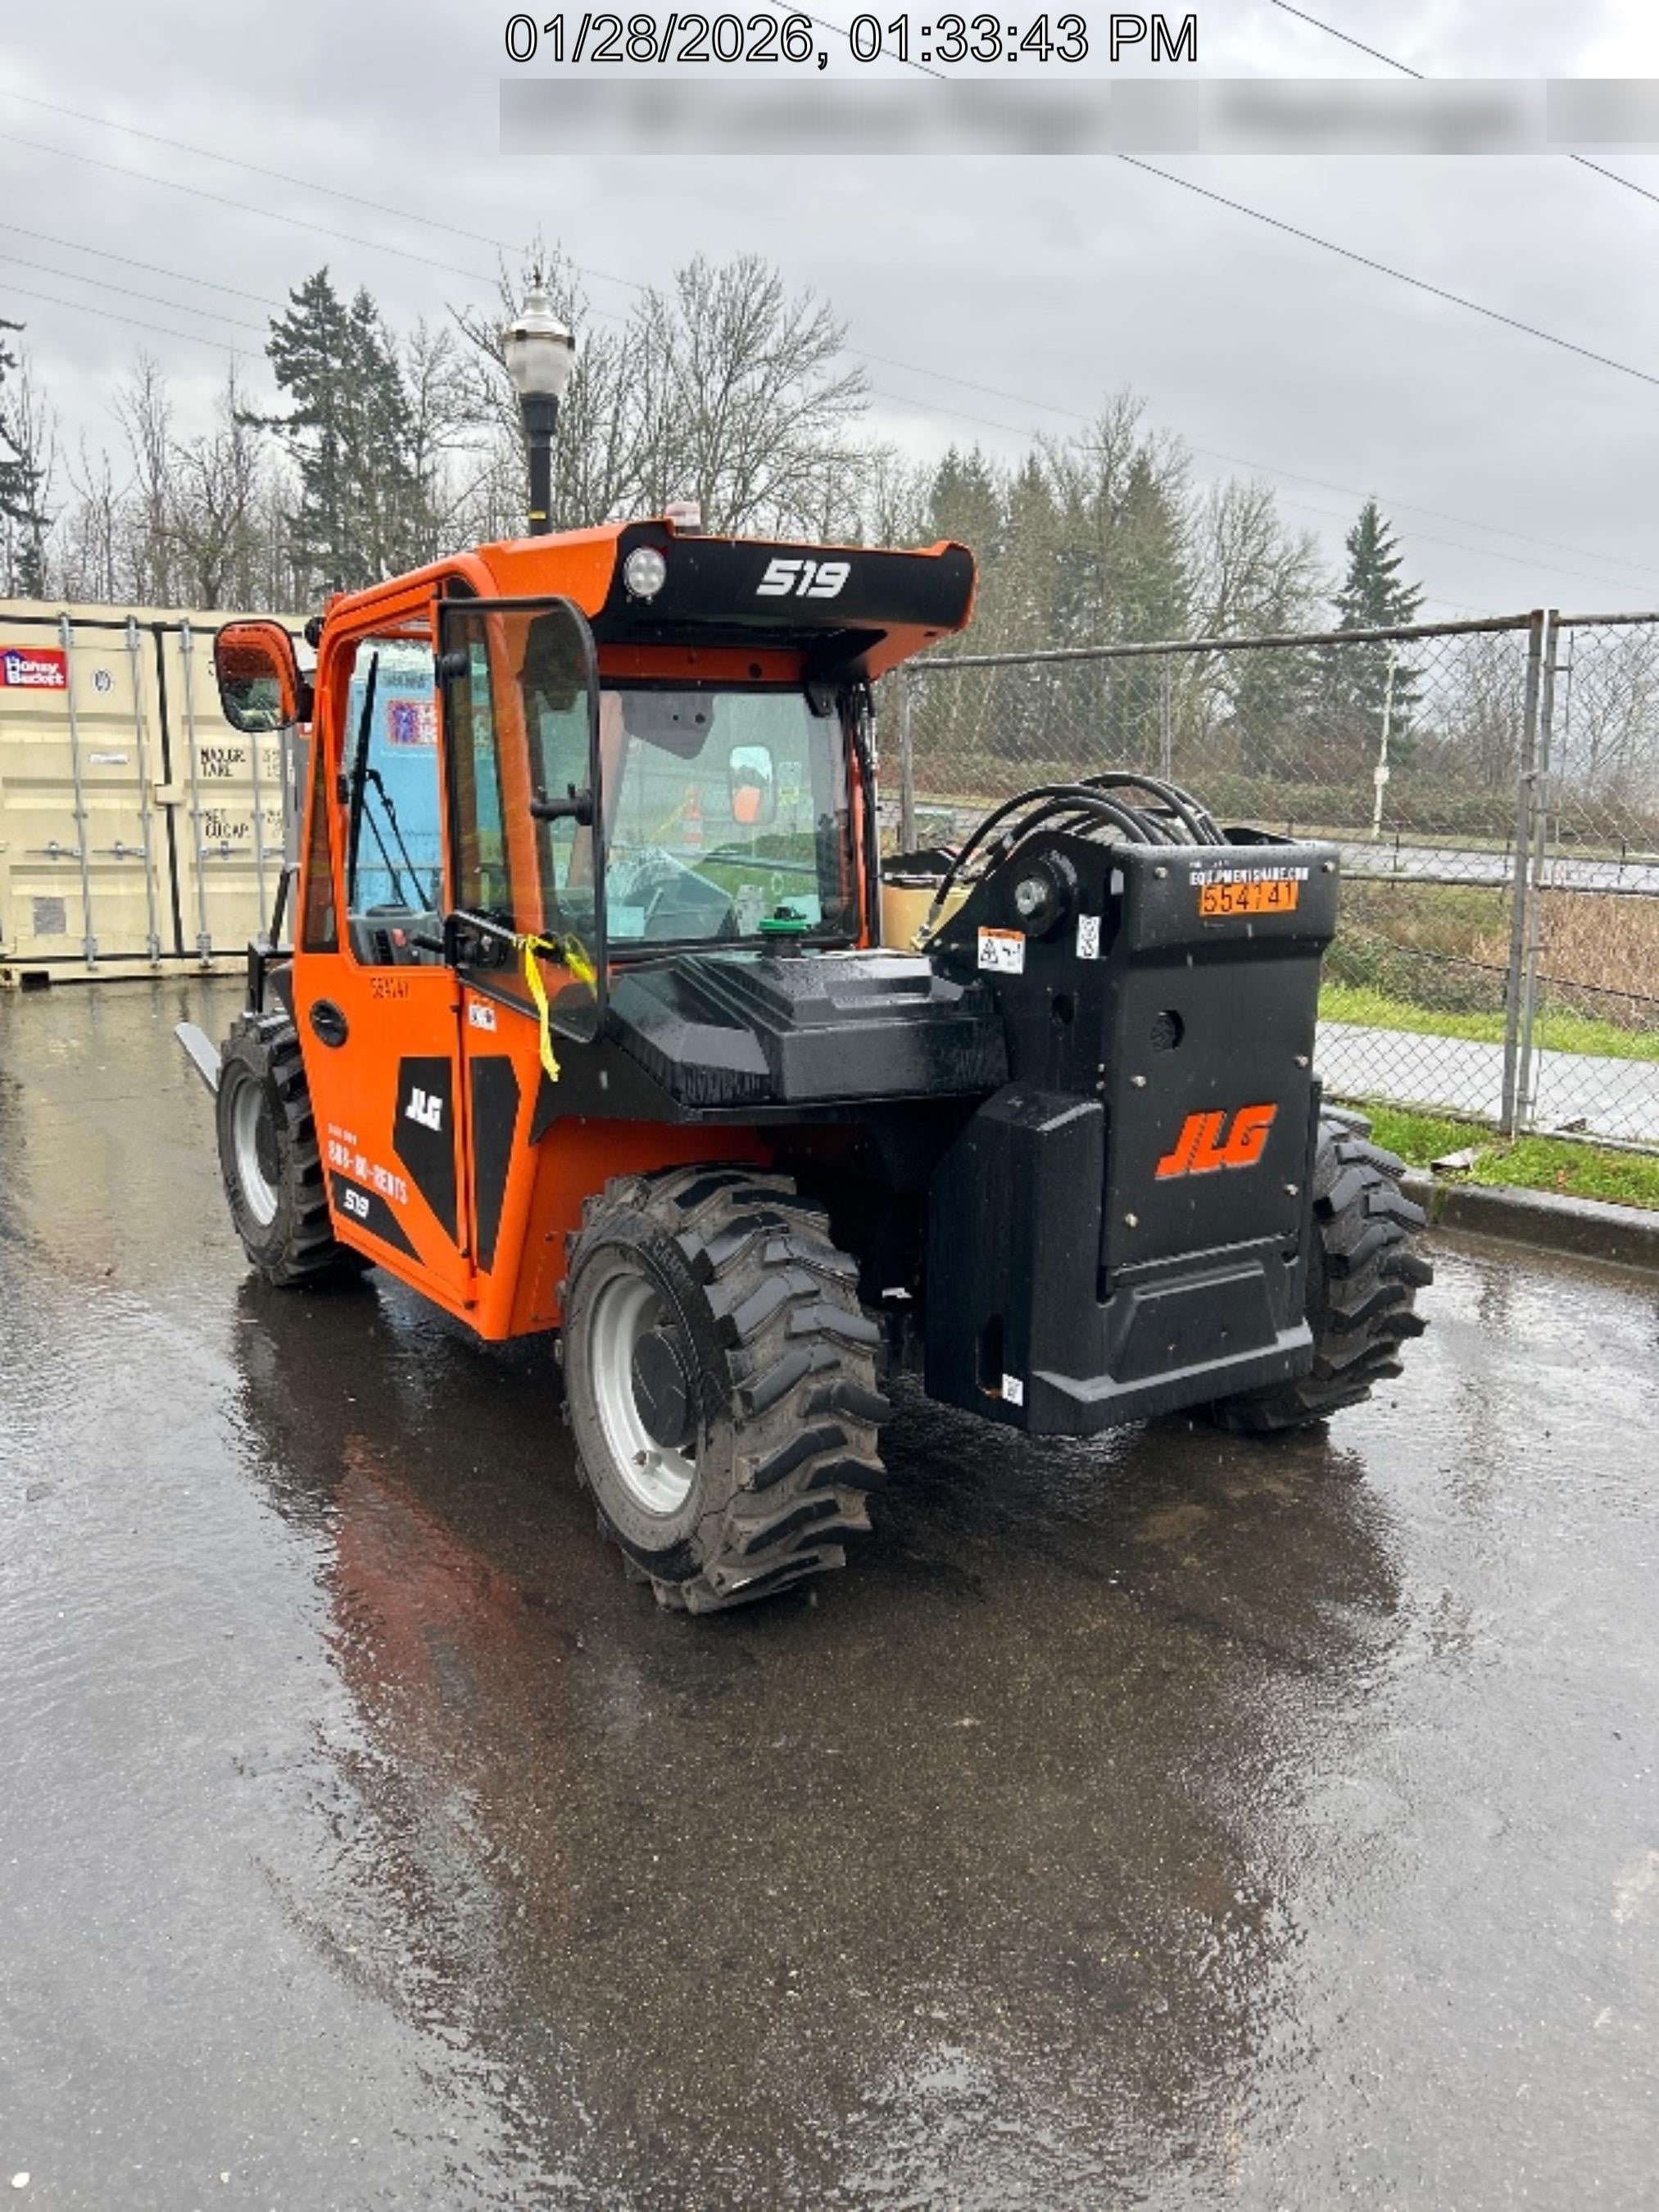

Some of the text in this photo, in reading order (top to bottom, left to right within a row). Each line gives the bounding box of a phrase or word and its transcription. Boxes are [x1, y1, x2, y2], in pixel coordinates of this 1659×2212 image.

[756, 558, 851, 598] 519
[405, 1086, 443, 1131] JLG
[1154, 1102, 1278, 1181] JLG
